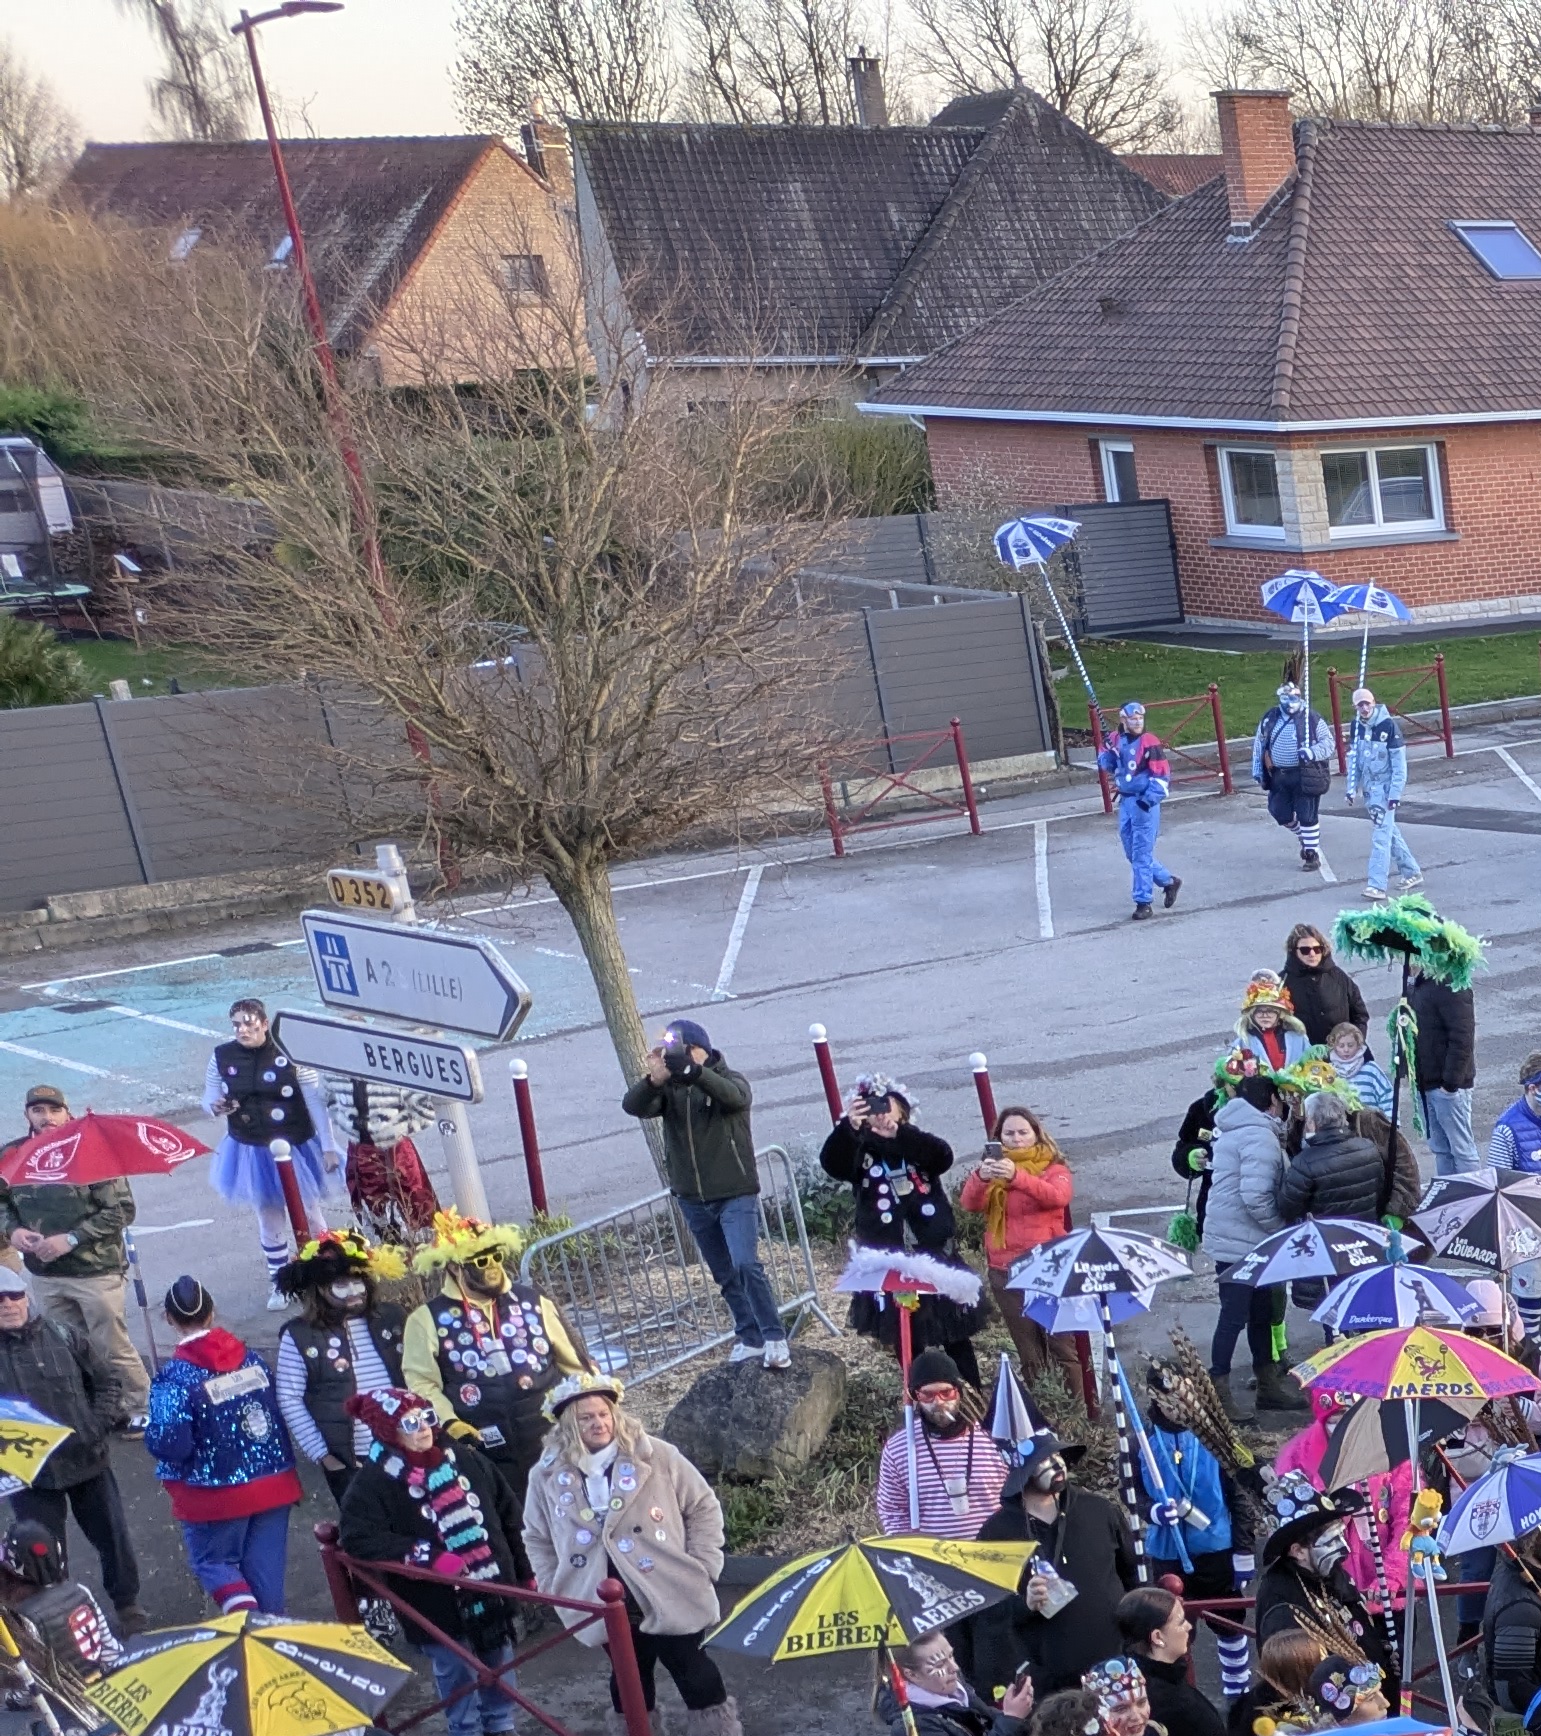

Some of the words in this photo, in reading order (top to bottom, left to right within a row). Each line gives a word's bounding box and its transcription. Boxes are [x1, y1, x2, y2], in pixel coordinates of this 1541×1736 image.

[331, 876, 344, 902] D
[349, 878, 391, 909] 352
[363, 1042, 463, 1086] BERGUES
[1447, 1242, 1497, 1266] LOUBARDS
[1455, 1236, 1468, 1248] Les
[1349, 1314, 1394, 1325] Dunkerque
[1390, 1382, 1474, 1398] NAERDS
[818, 1611, 859, 1628] LES
[911, 1589, 986, 1634] AERES
[124, 1677, 152, 1703] LES
